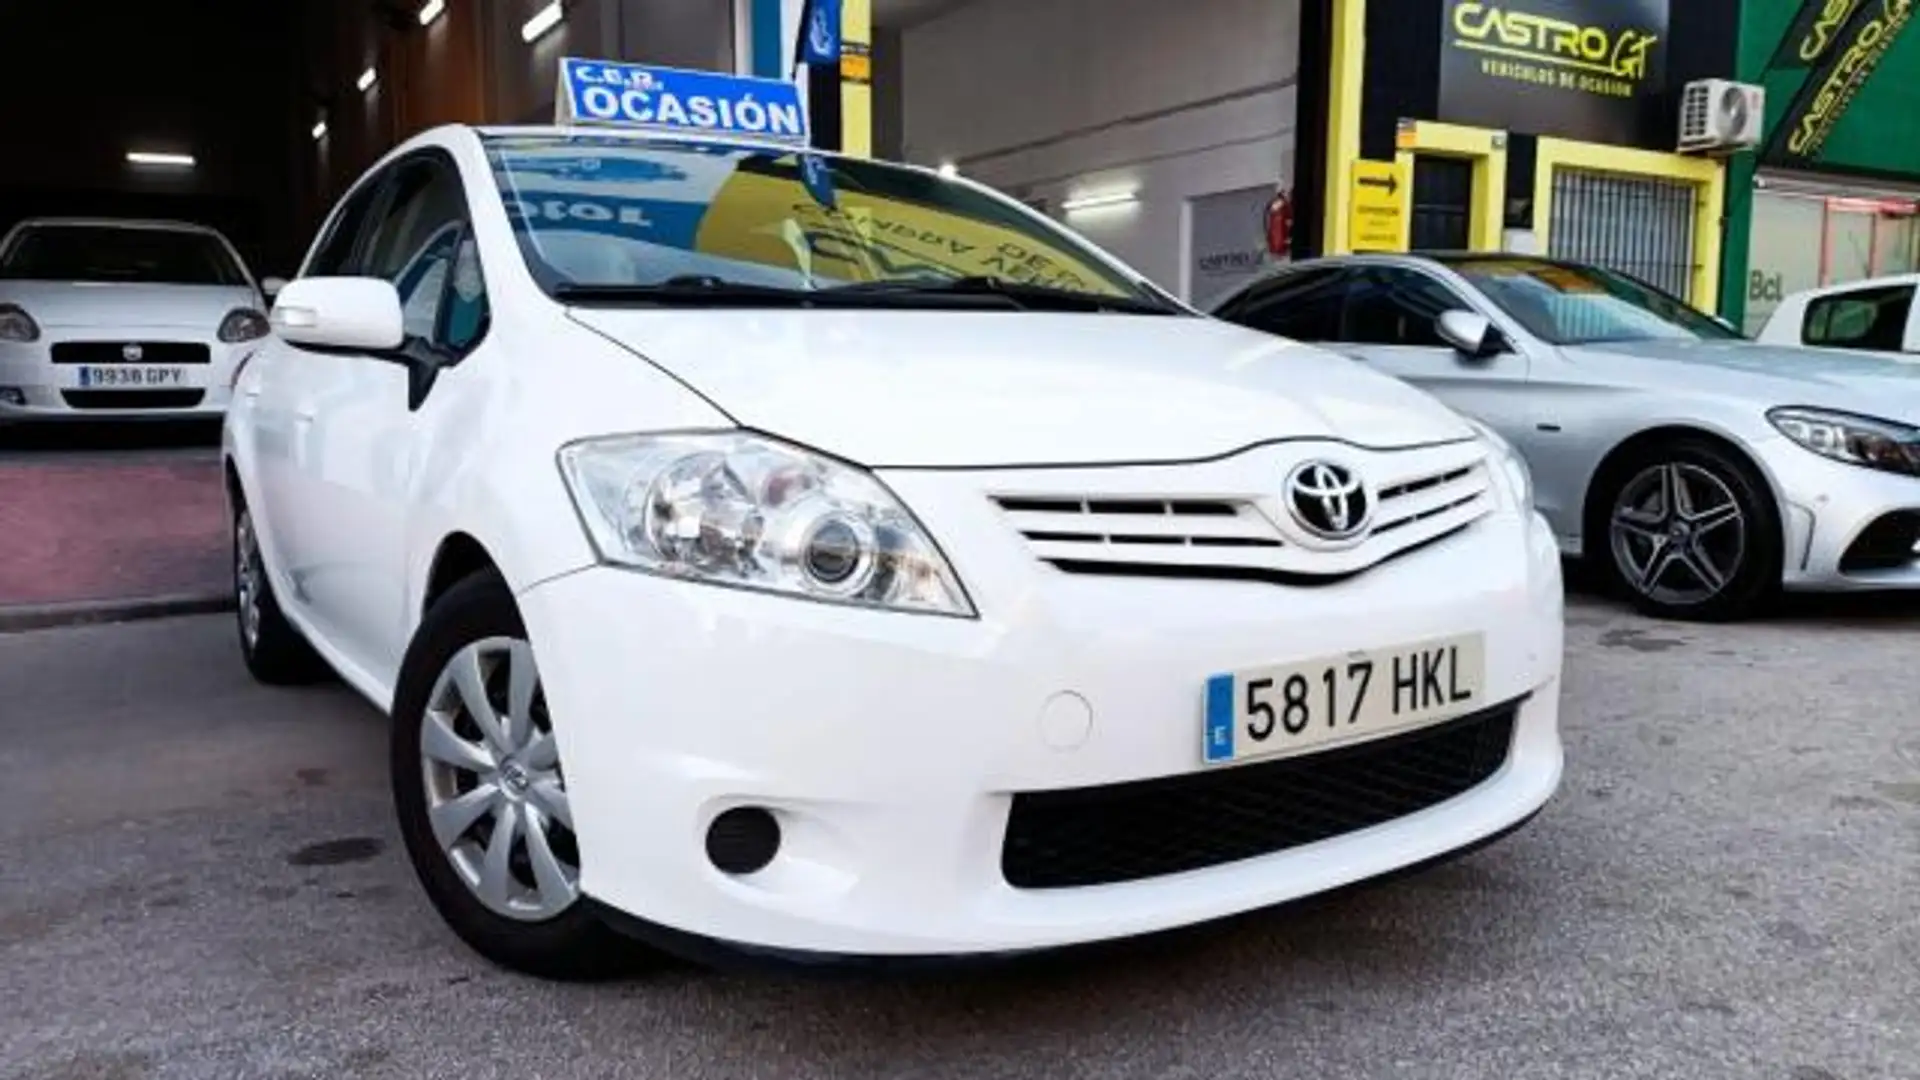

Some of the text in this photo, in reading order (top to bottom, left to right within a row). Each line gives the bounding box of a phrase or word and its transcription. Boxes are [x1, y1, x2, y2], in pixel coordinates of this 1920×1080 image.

[1454, 3, 1608, 60] CASTRO
[583, 92, 800, 133] OCASIÓN
[1788, 20, 1882, 154] CASTRO
[145, 366, 182, 384] GPY
[1246, 644, 1472, 742] 5817 HKL
